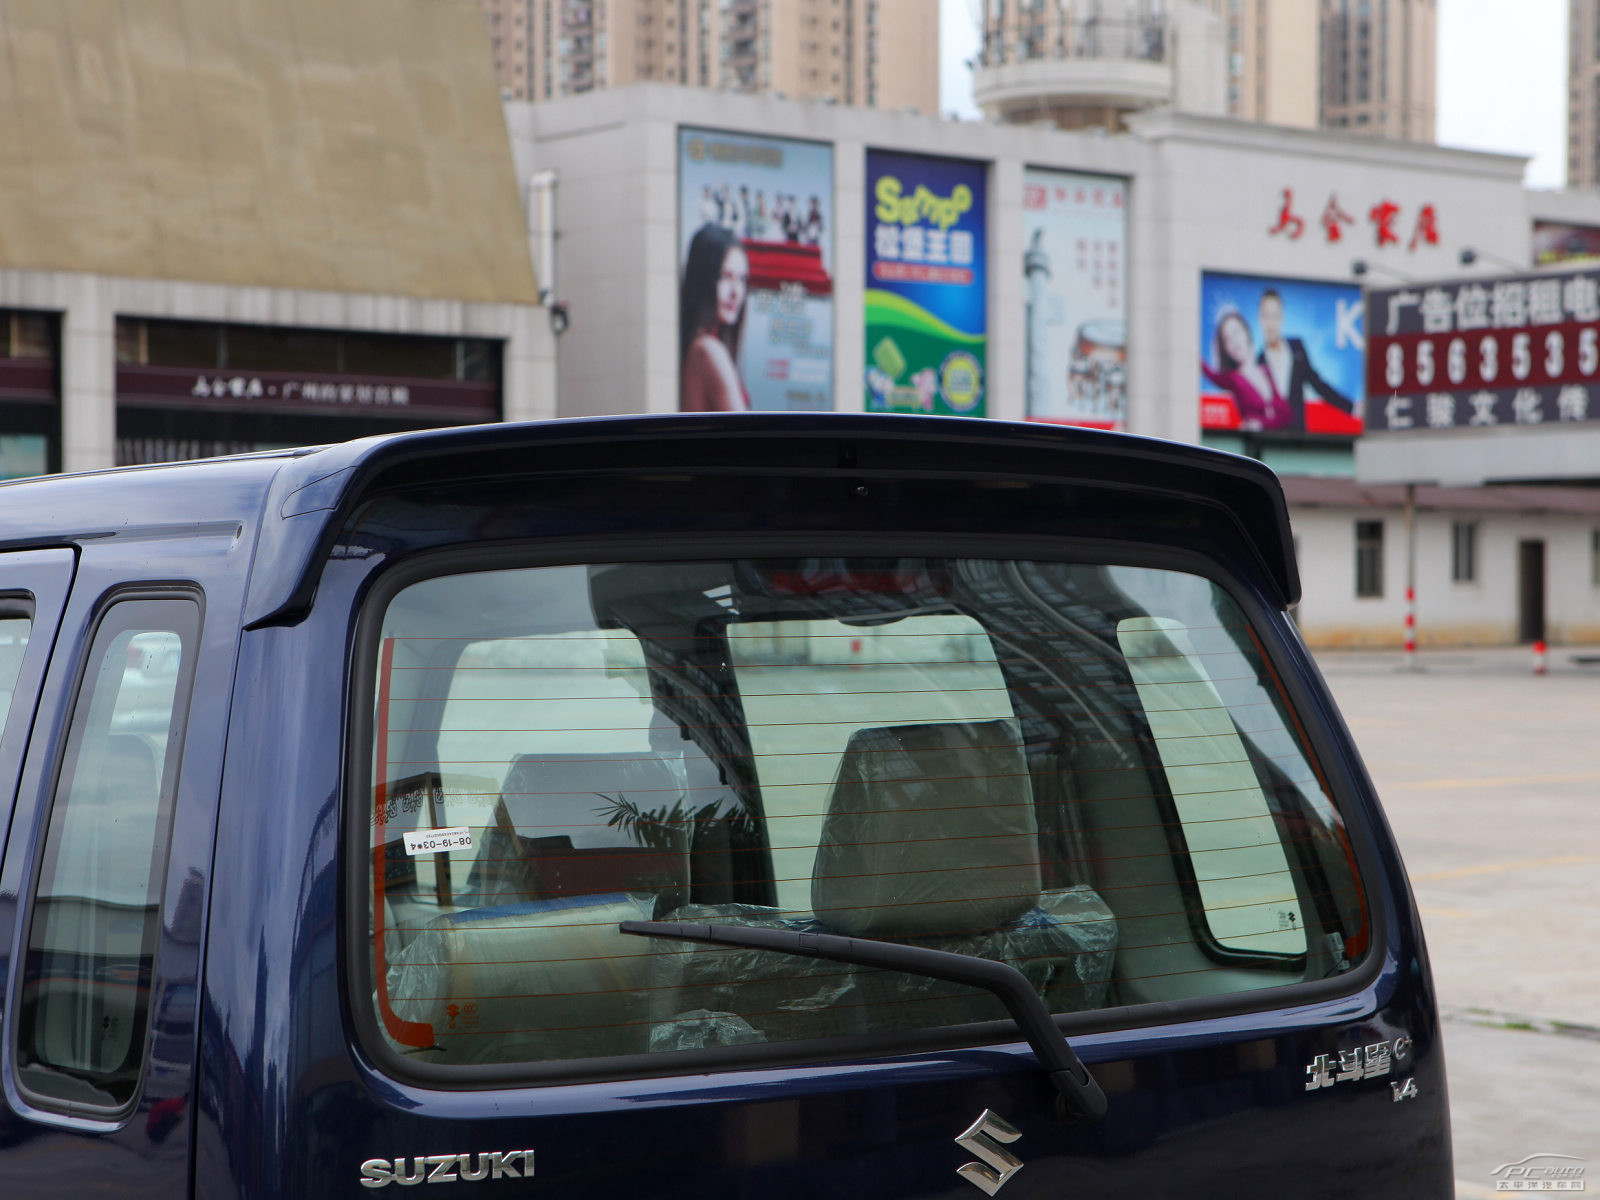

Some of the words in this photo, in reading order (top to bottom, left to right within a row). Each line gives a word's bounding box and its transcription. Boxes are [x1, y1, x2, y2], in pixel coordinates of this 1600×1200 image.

[1385, 327, 1599, 388] 8563535
[1305, 1040, 1391, 1090] 北斗星
[359, 1149, 536, 1188] SUZUKI
